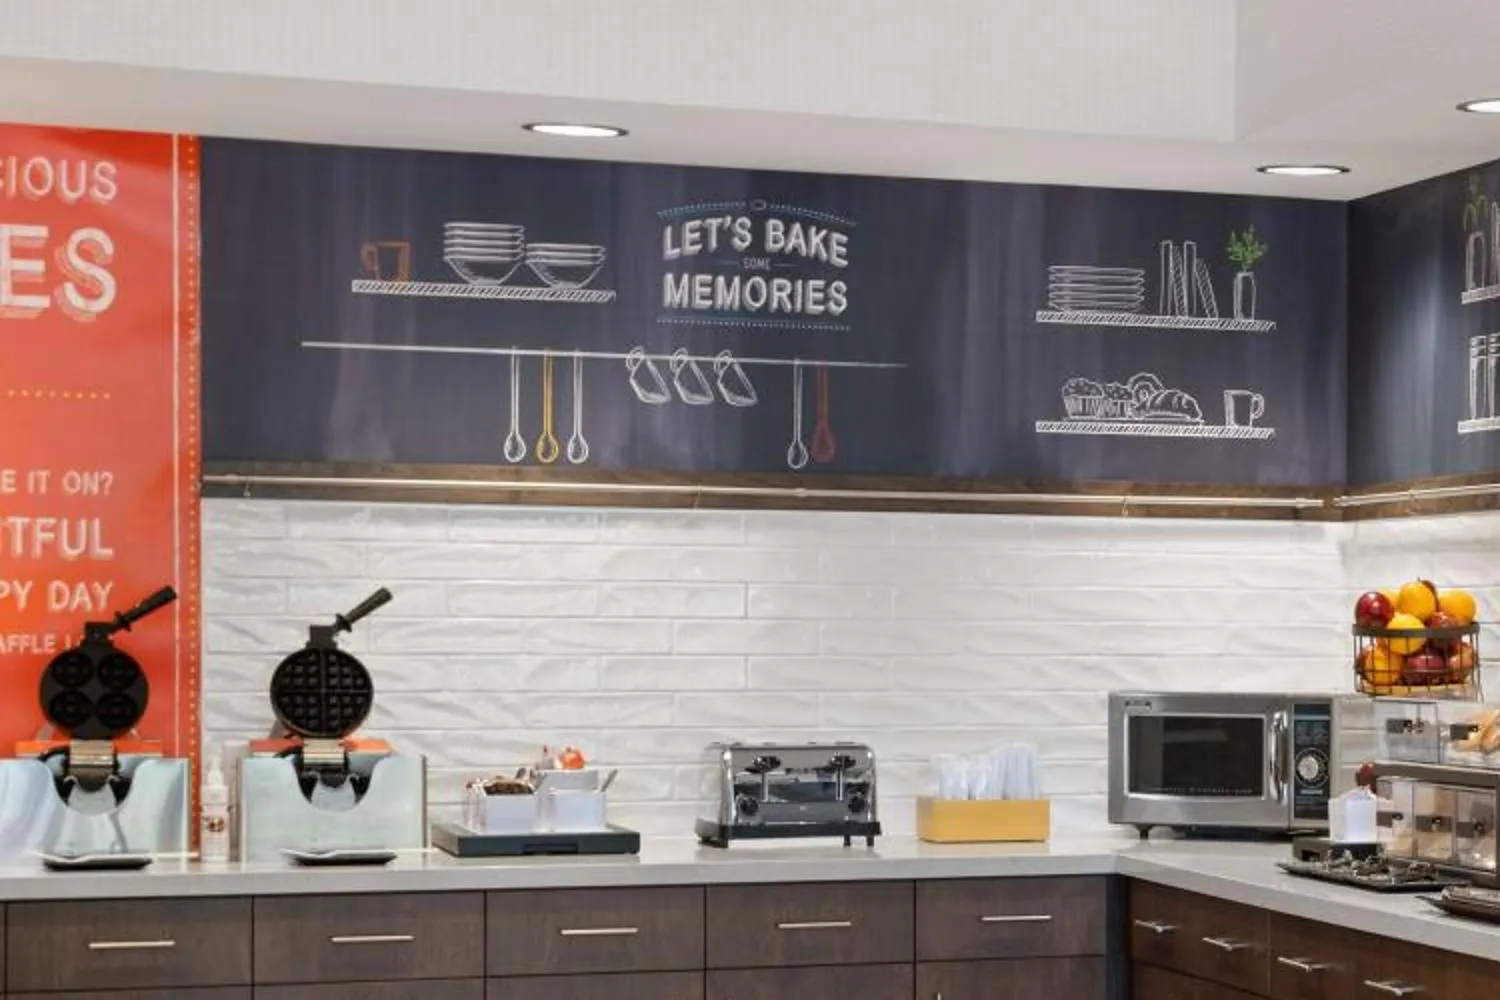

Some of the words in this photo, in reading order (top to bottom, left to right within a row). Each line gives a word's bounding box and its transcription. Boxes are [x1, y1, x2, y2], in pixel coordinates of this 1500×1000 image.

[0, 156, 118, 202] IOUS
[662, 215, 753, 261] LET'S
[764, 217, 849, 268] BAKE
[662, 272, 848, 316] MEMORIES
[28, 470, 51, 495] IT
[61, 471, 114, 496] ON?
[47, 580, 114, 613] DAY
